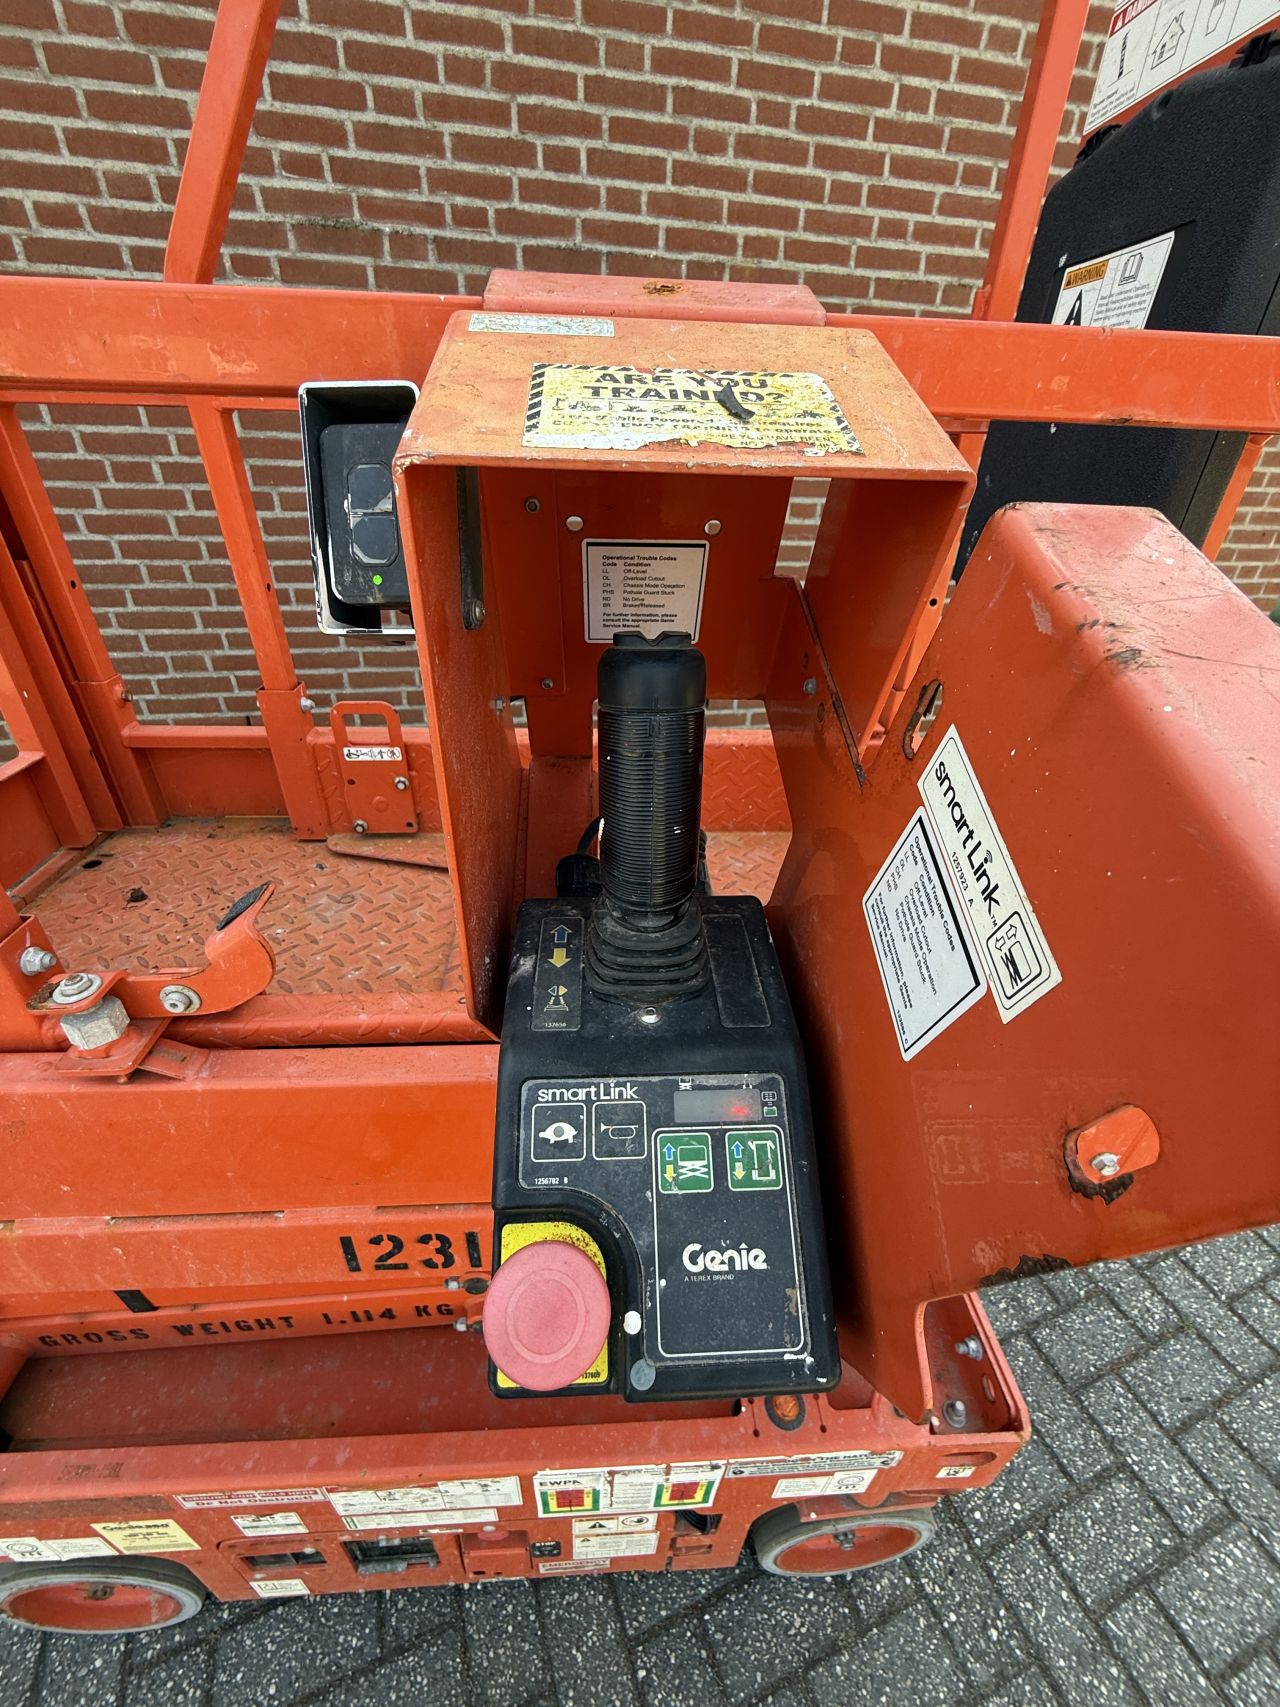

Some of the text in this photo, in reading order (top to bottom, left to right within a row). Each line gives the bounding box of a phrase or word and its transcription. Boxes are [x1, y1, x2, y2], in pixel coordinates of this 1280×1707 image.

[1072, 264, 1106, 283] WARNING
[583, 386, 786, 402] TRAIND?
[594, 373, 768, 389] ARE YOU
[909, 843, 935, 916] Code Condition
[914, 835, 955, 951] Operational Trouble Codes
[914, 881, 928, 918] Off-Level
[951, 851, 974, 907] 1257923 A
[871, 903, 880, 930] Service
[894, 908, 900, 920] No
[898, 920, 906, 942] Drive
[909, 888, 923, 924] Overload
[920, 925, 932, 954] Cutout
[874, 897, 884, 924] consult
[886, 939, 900, 983] appropriate
[899, 984, 907, 1009] Genie
[882, 905, 891, 930] further
[889, 932, 903, 979] information,
[902, 981, 912, 1008] please
[899, 901, 910, 931] Pothole
[908, 932, 919, 958] Guard
[916, 959, 926, 984] Stuck
[904, 895, 915, 927] Chassis
[914, 926, 923, 951] Mode
[922, 952, 936, 995] Operation
[535, 1177, 560, 1185] 1256702
[339, 1231, 483, 1272] 1231
[682, 1242, 768, 1273] Genie
[38, 1303, 454, 1347] GROSS WEIGHT 1.114 KG
